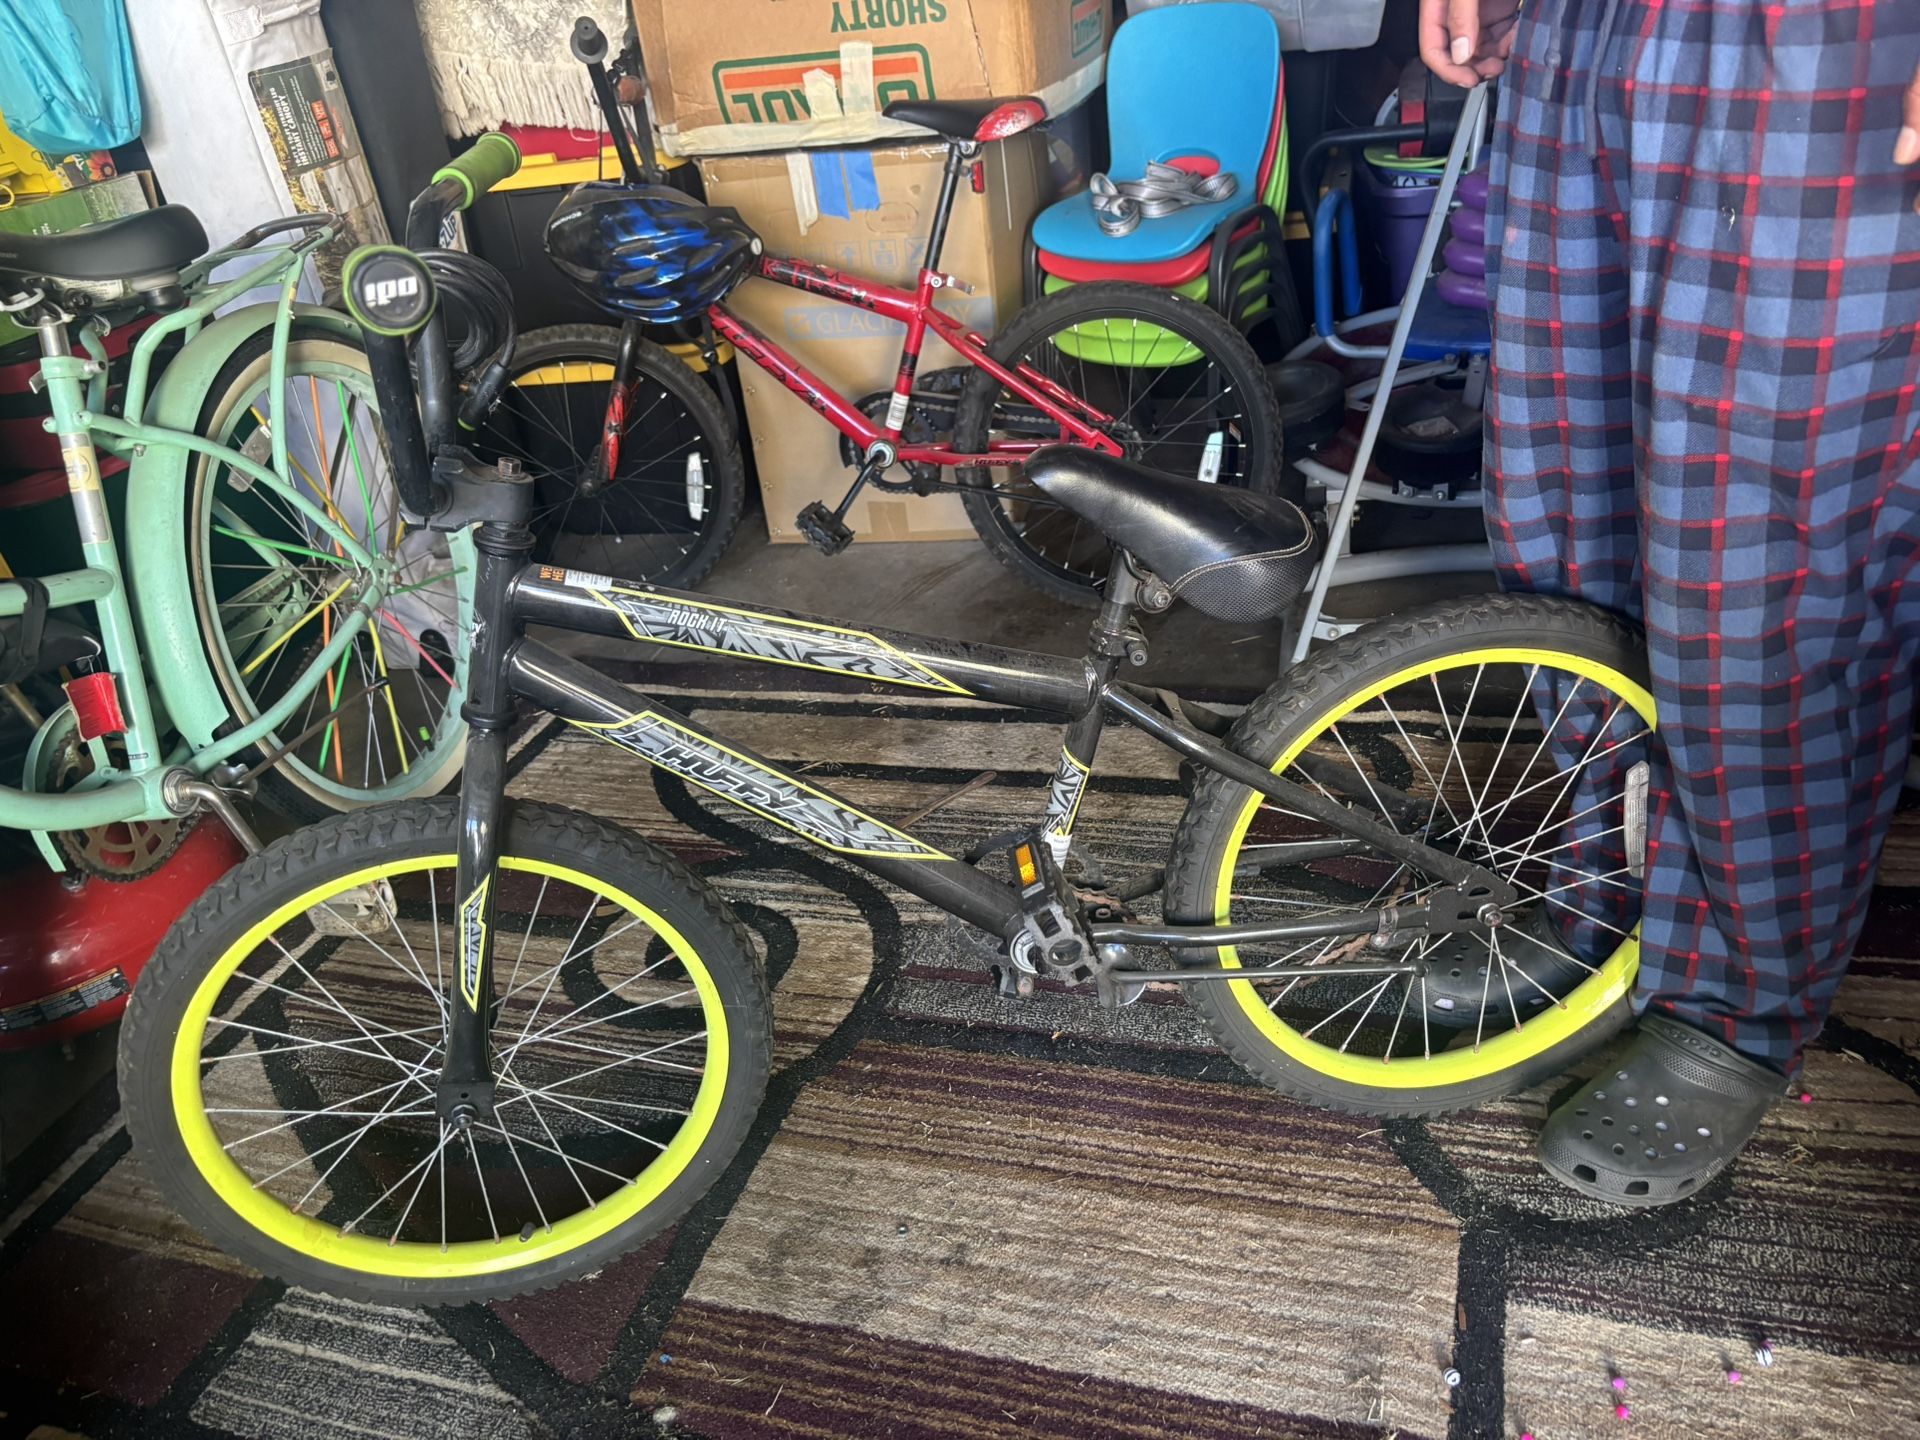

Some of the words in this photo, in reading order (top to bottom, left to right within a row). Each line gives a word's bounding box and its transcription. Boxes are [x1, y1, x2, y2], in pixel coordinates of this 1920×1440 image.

[831, 0, 947, 33] SHORTY
[279, 95, 296, 130] CANOPY
[292, 132, 309, 166] INSTANT
[365, 276, 418, 308] odi
[667, 609, 708, 630] ROCK
[709, 617, 728, 633] IT
[659, 743, 807, 811] HUFFY
